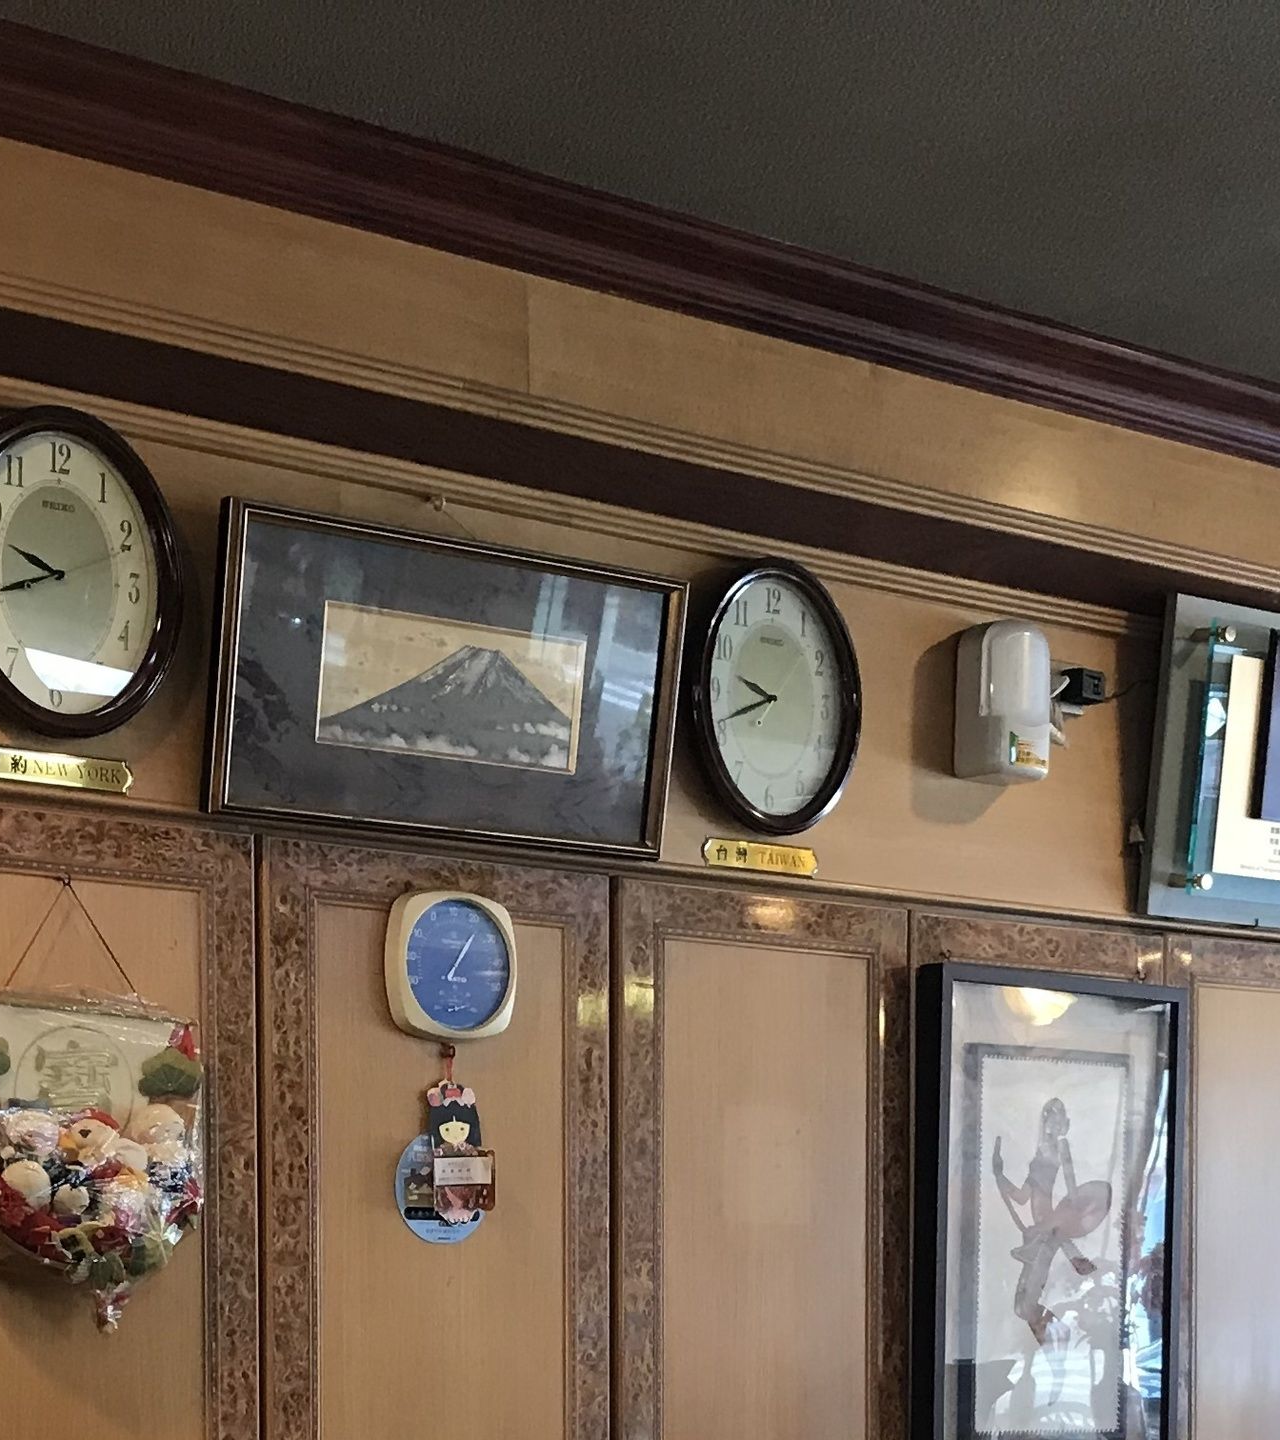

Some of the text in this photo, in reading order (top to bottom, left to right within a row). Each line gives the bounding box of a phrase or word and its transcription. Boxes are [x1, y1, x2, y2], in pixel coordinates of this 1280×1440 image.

[5, 455, 24, 488] 11
[49, 442, 71, 475] 12
[97, 472, 107, 503] 1
[119, 520, 132, 552] 2
[127, 573, 140, 604] 3
[765, 588, 782, 615] 12
[733, 600, 748, 627] 11
[801, 611, 807, 637] 1
[117, 620, 129, 651] 4
[716, 634, 732, 660] 10
[6, 647, 19, 679] 7
[815, 650, 824, 676] 2
[712, 677, 720, 702] 9
[820, 695, 829, 721] 3
[718, 719, 727, 747] 8
[32, 758, 67, 777] NEW
[76, 763, 121, 784] YORK
[734, 761, 743, 787] 7
[795, 771, 805, 797] 5
[764, 784, 774, 809] 6
[759, 851, 807, 868] TAIWAN
